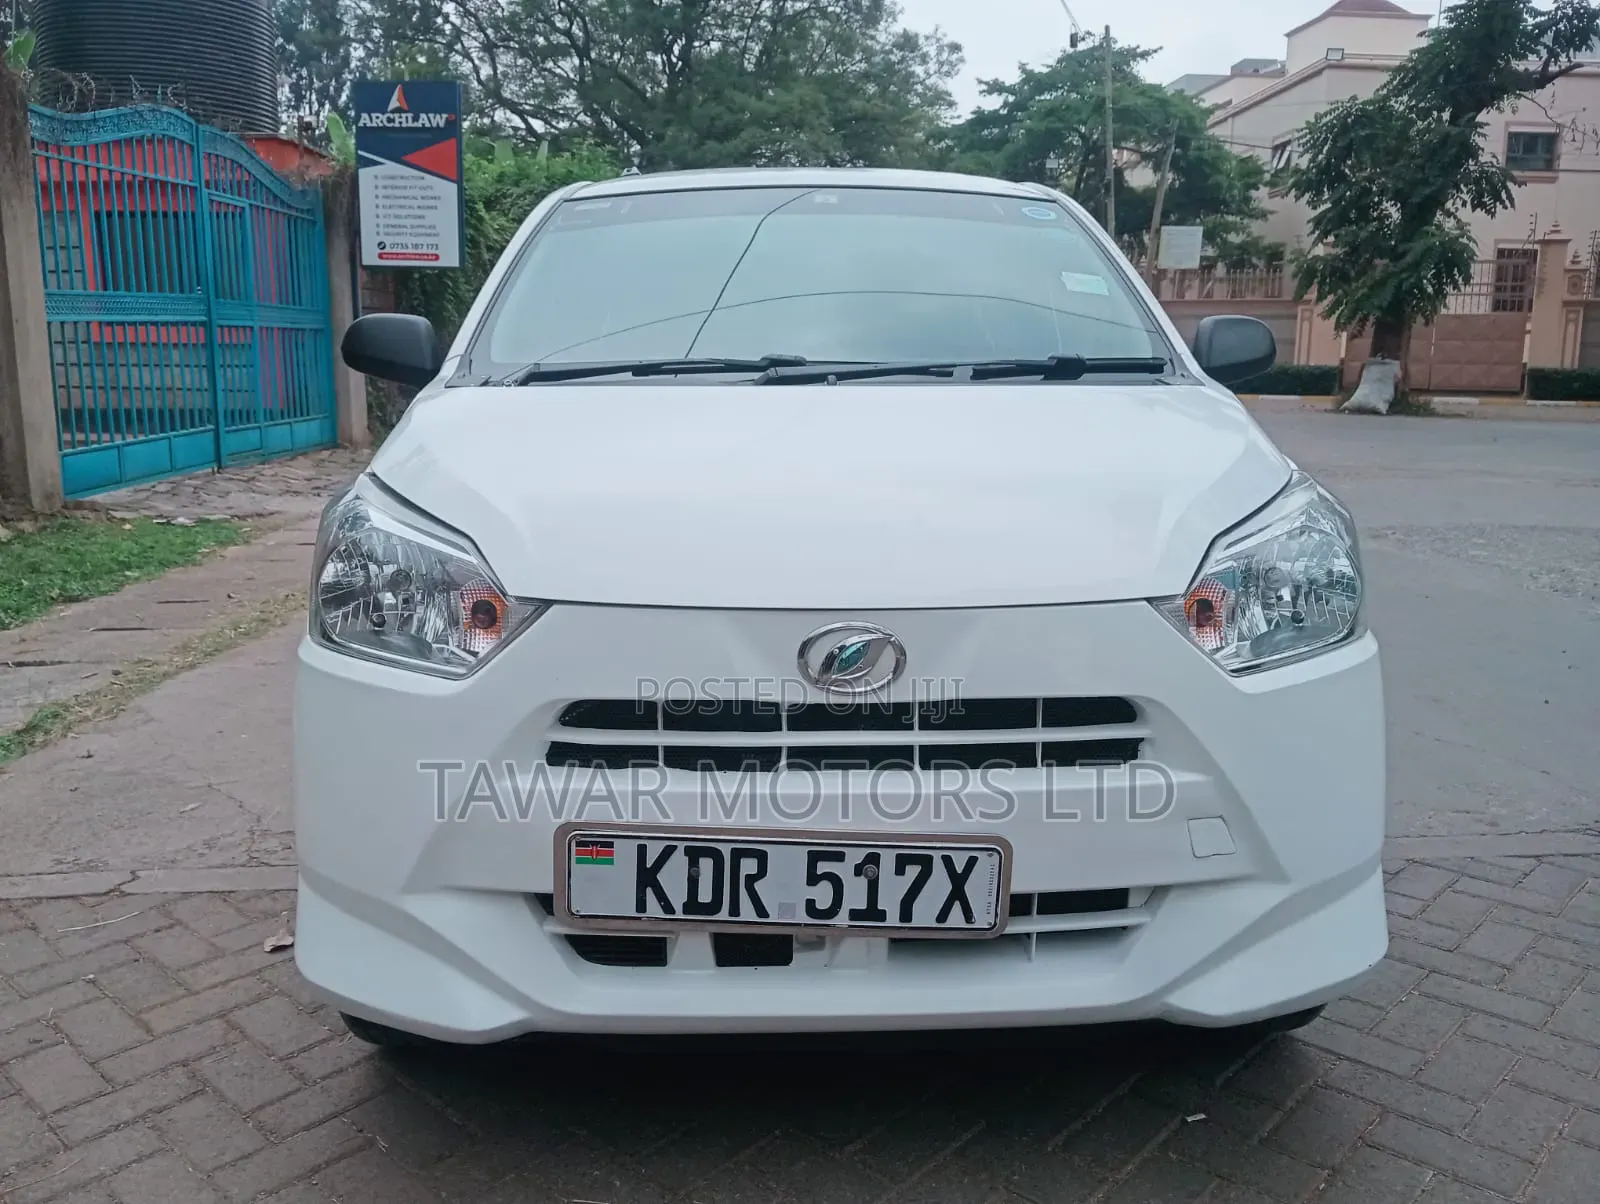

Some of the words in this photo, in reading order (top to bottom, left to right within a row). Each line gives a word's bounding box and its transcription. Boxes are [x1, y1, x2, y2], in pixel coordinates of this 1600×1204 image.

[358, 112, 448, 128] ARCHLAW
[635, 843, 770, 919] KDR
[805, 849, 979, 925] 517X
